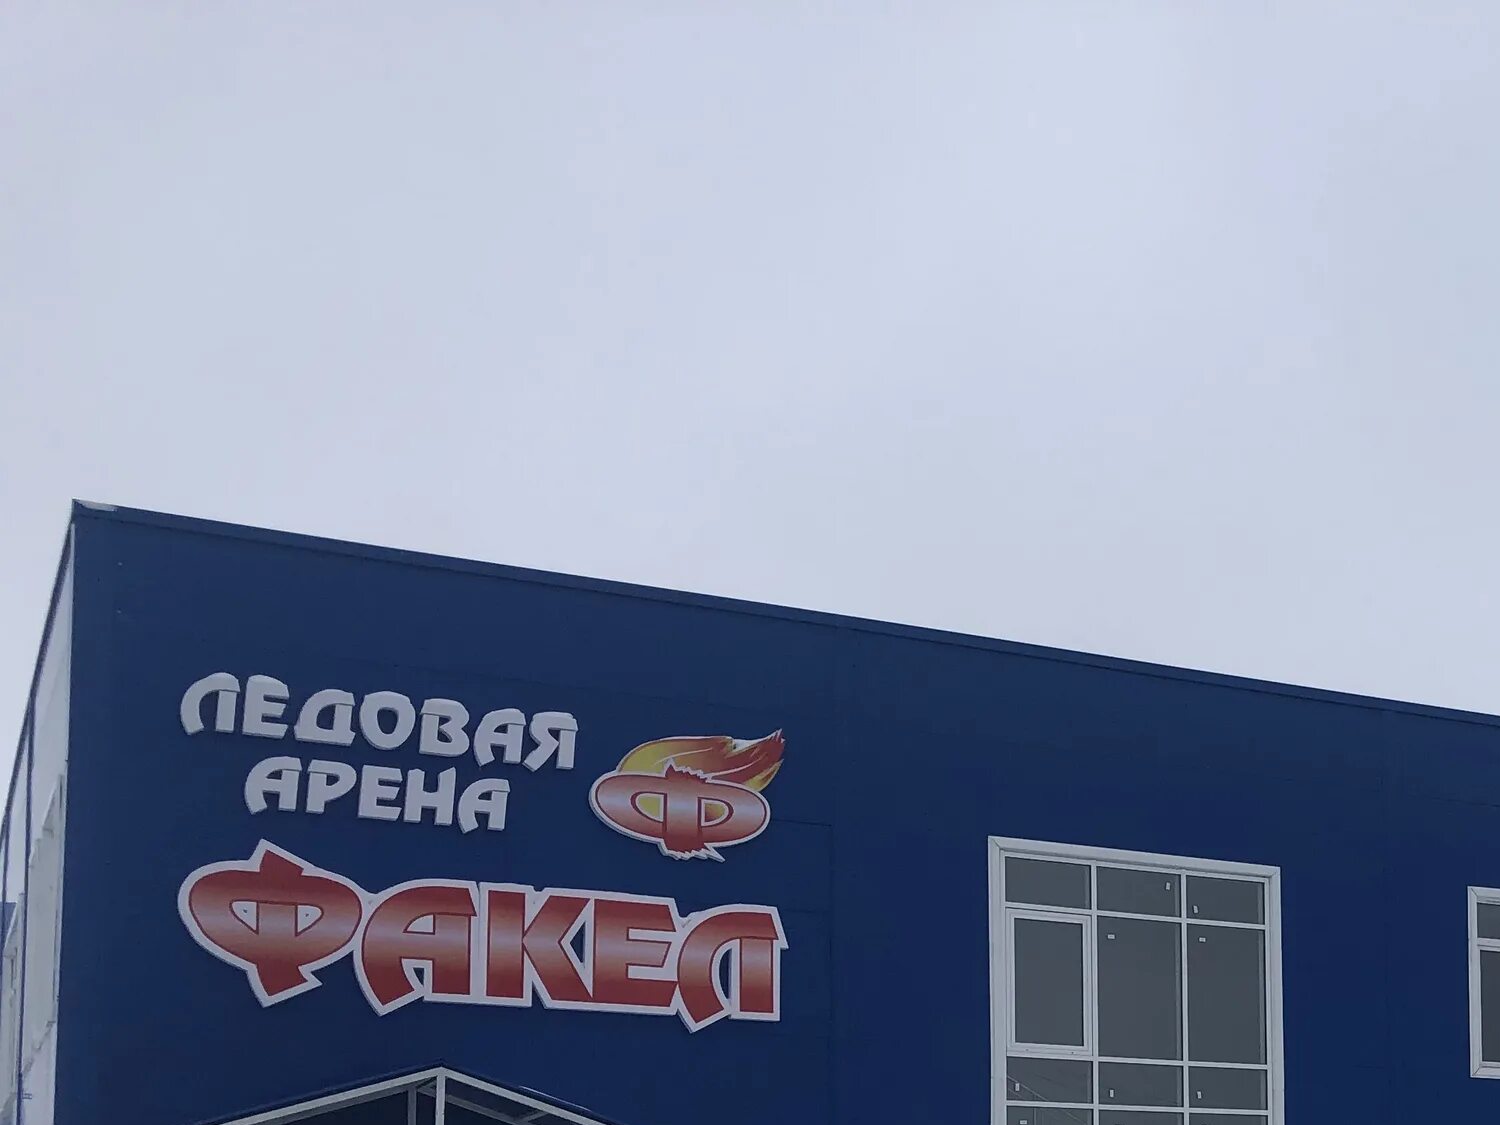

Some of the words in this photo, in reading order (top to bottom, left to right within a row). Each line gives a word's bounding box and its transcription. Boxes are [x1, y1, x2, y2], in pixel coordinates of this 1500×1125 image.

[180, 672, 579, 771] ЛЕДОВАЯ
[243, 756, 511, 833] АРЕНА
[177, 838, 789, 1033] ФАКЕЛ
